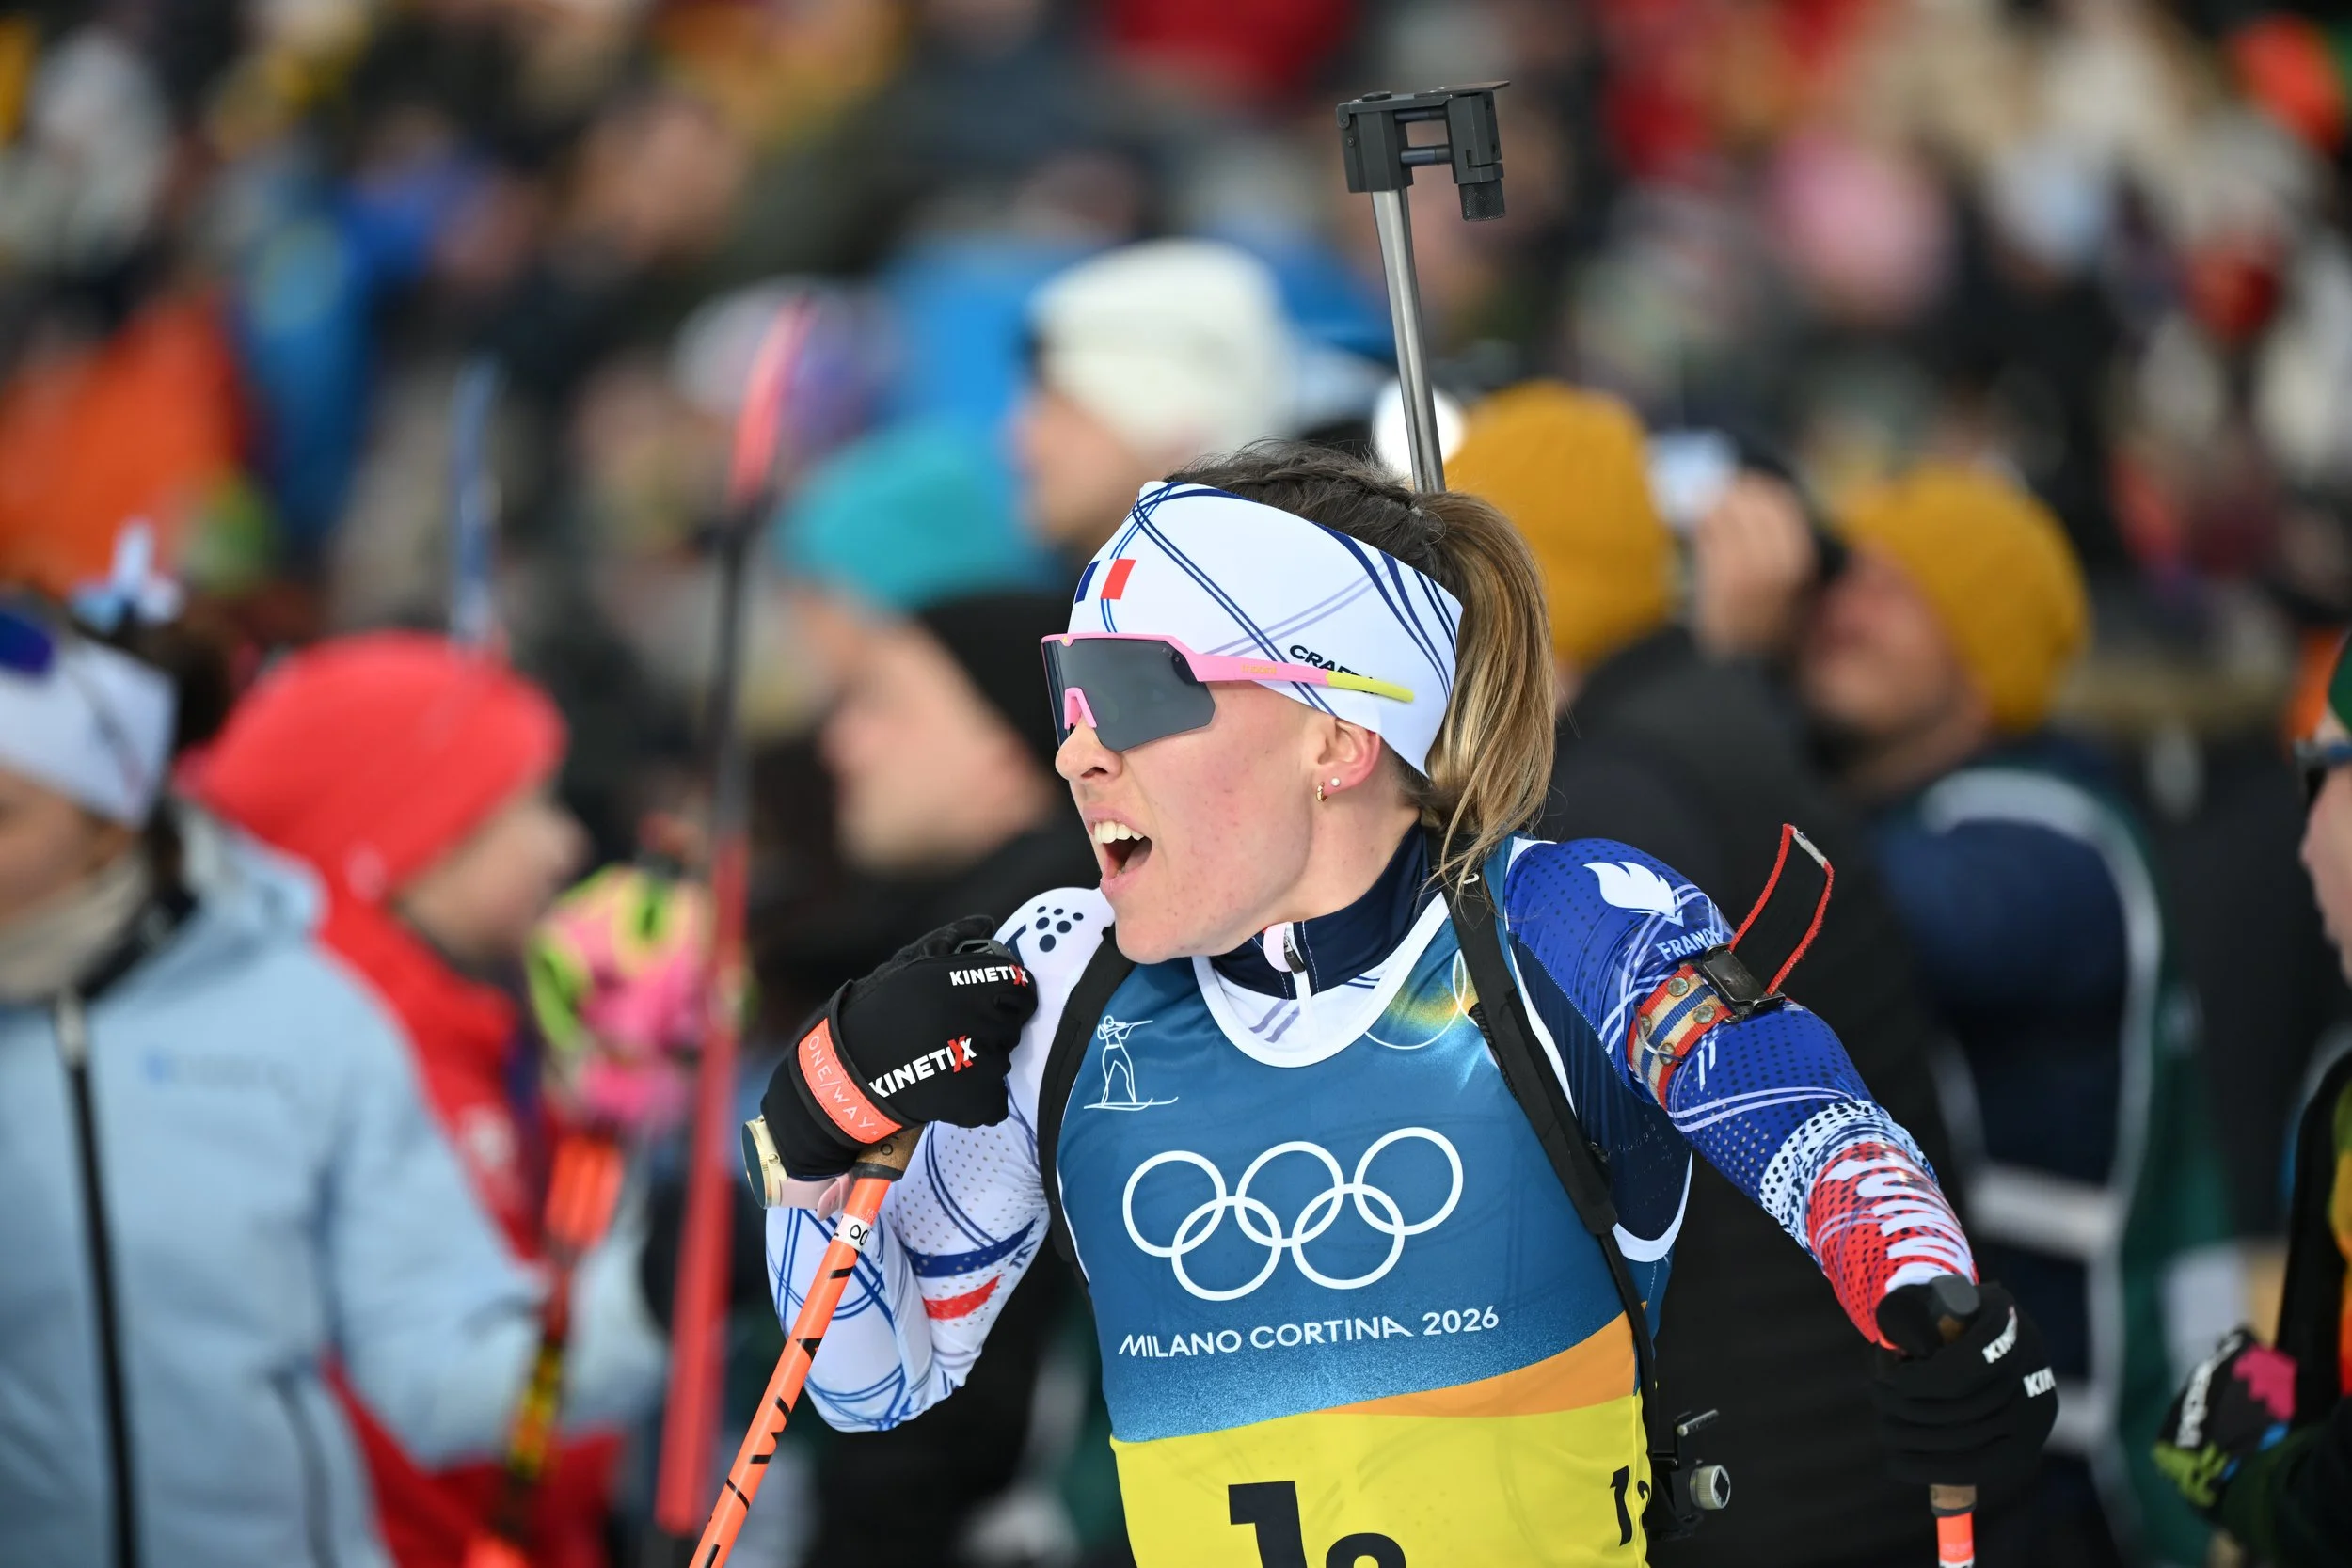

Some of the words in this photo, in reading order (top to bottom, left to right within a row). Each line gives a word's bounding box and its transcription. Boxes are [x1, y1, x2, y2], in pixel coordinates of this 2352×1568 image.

[1290, 645, 1361, 676] CRA
[868, 1035, 977, 1098] KINETIXX
[1119, 1328, 1242, 1357] MILANO
[1249, 1315, 1414, 1349] CORTINA
[1422, 1305, 1500, 1336] 2026
